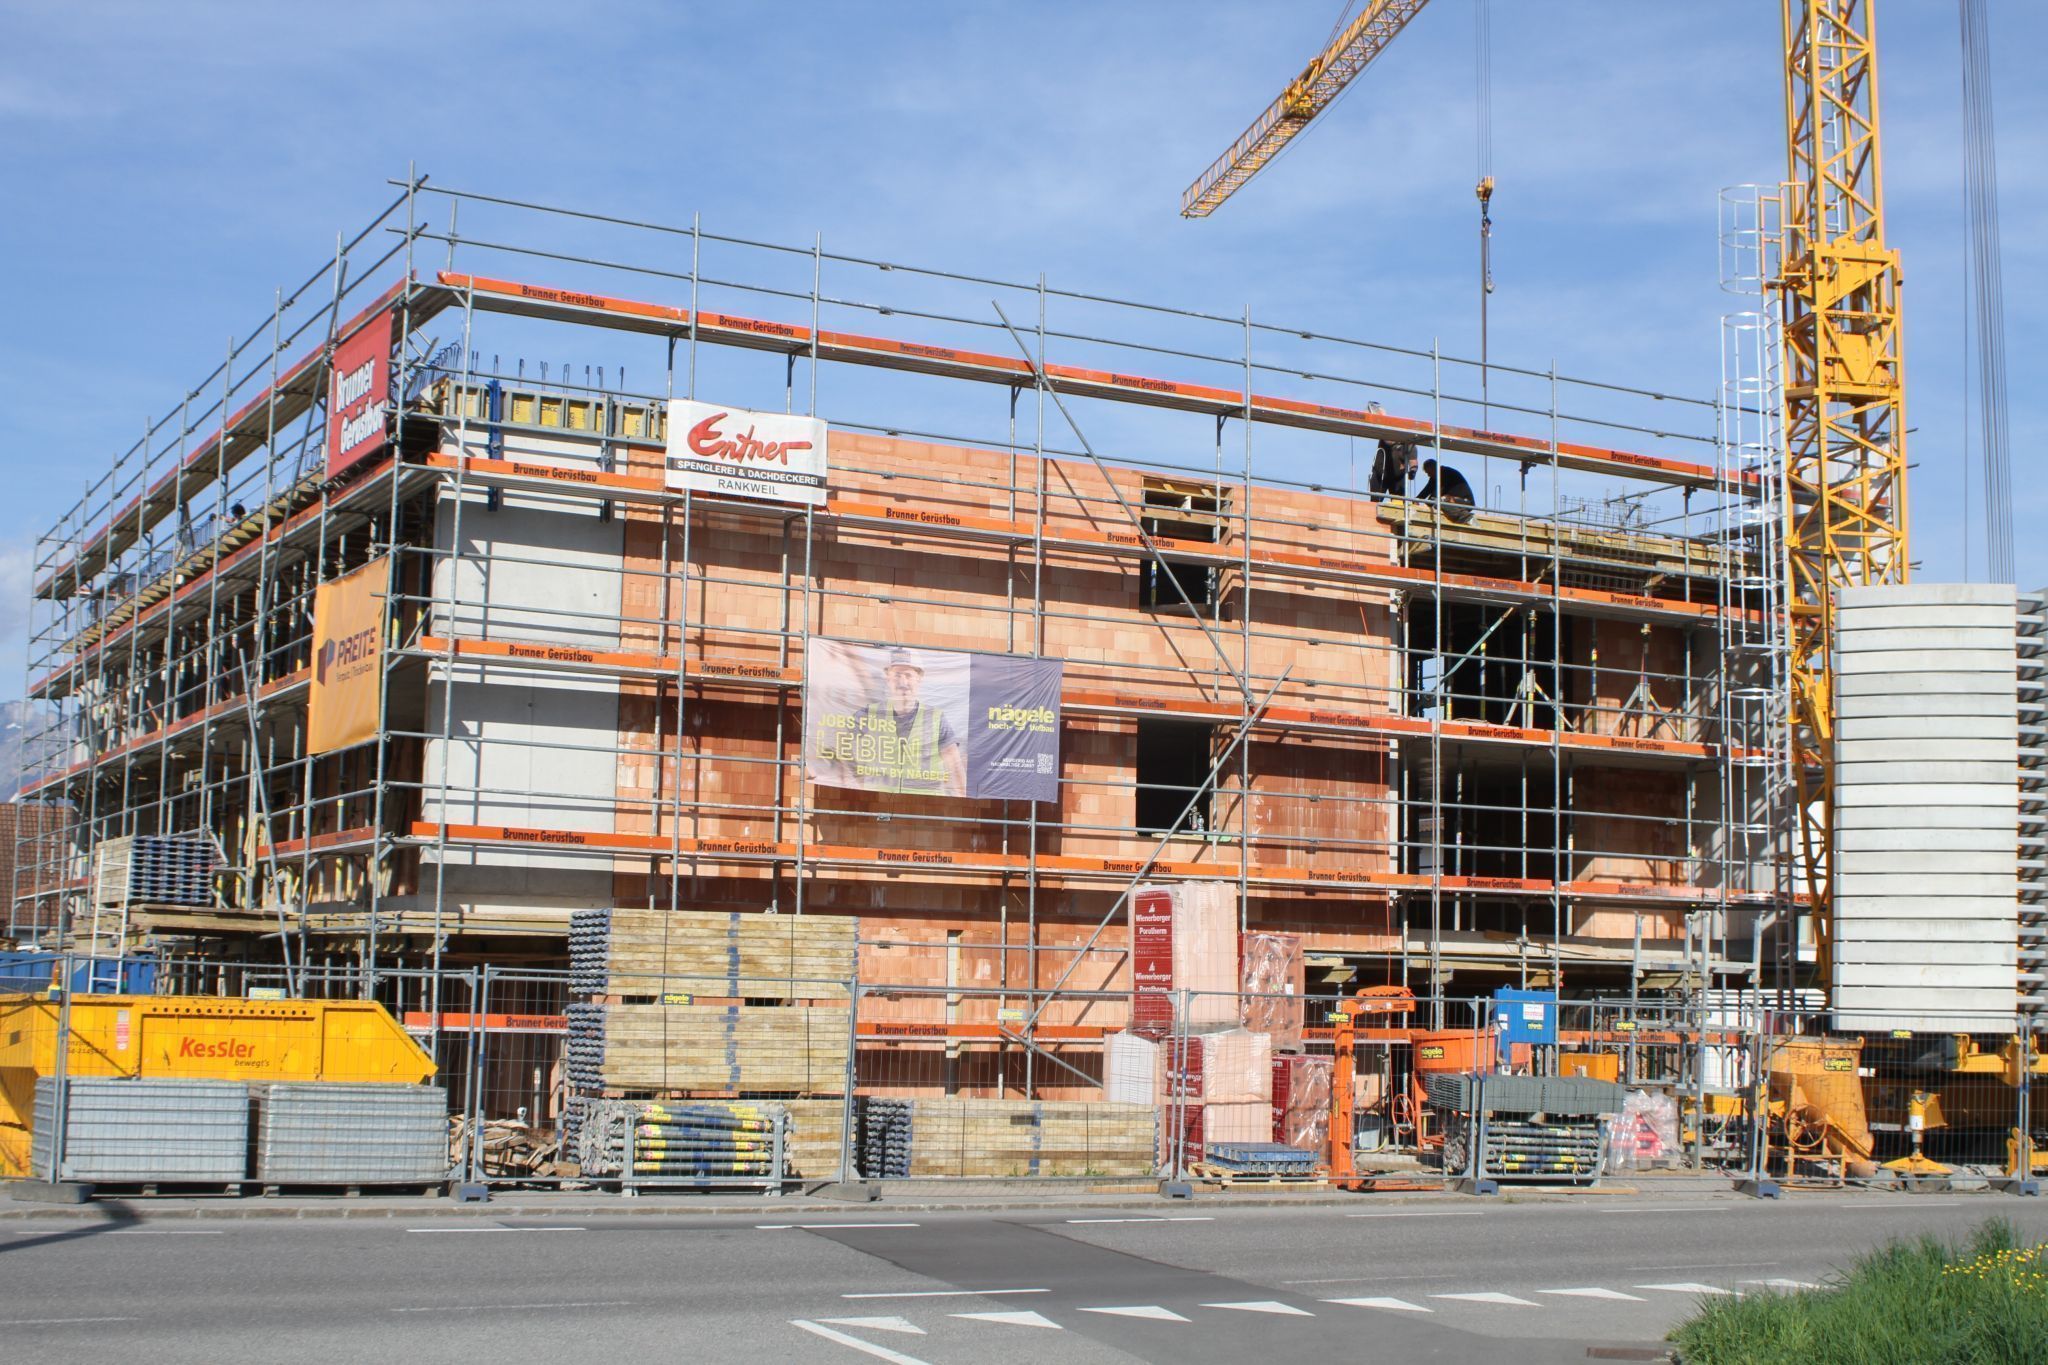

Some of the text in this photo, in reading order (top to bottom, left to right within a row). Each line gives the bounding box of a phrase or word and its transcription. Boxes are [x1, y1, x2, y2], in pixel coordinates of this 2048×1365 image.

[522, 285, 605, 308] Brunner Gerüstbau
[719, 315, 794, 336] Brunner Gerüstbau
[336, 356, 375, 415] Brunner
[1111, 374, 1176, 391] Brunner Gerüstbau
[340, 394, 386, 454] Gerüstbau
[686, 412, 813, 466] Entner
[1611, 450, 1662, 468] Brunner Gerüstbau
[513, 463, 597, 483] Brunner Gerüstbau
[677, 460, 818, 486] SPENGLEREI & DACHDECKEREI
[718, 479, 779, 496] RANKWEIL
[886, 508, 960, 526] Brunner Gerüstbau
[1107, 532, 1136, 545] Brunner
[1319, 558, 1339, 569] Brunner
[1610, 594, 1664, 609] Brunner Gerüstbau
[337, 627, 376, 668] PREITE
[509, 645, 593, 663] Brunner Gerüstbau
[738, 664, 781, 678] Gerüstbau
[1115, 697, 1137, 707] Brunner
[988, 703, 1055, 726] nägele
[1310, 712, 1369, 727] Brunner Gerüstbau
[817, 713, 897, 732] JOBS FÜRS
[1468, 726, 1523, 739] Brunner Gerüstbau
[816, 730, 921, 767] LEBEN
[1611, 738, 1664, 751] Brunner Gerüstbau
[856, 765, 887, 777] BUILT
[890, 768, 903, 778] BY
[503, 828, 584, 844] Brunner Gerüstbau
[734, 842, 777, 854] Gerüstbau
[878, 850, 952, 864] Brunner Gerüstbau
[1103, 861, 1133, 872] Brunner
[1308, 871, 1371, 882] Brunner Gerüstbau
[1467, 877, 1523, 889] Brunner Gerüstbau
[1135, 914, 1172, 923] Wienerberger
[1139, 926, 1168, 935] Porotherm
[1135, 972, 1172, 982] Wienerberger
[506, 1016, 541, 1028] Brunner
[875, 1024, 948, 1036] Brunner Gerüstbau
